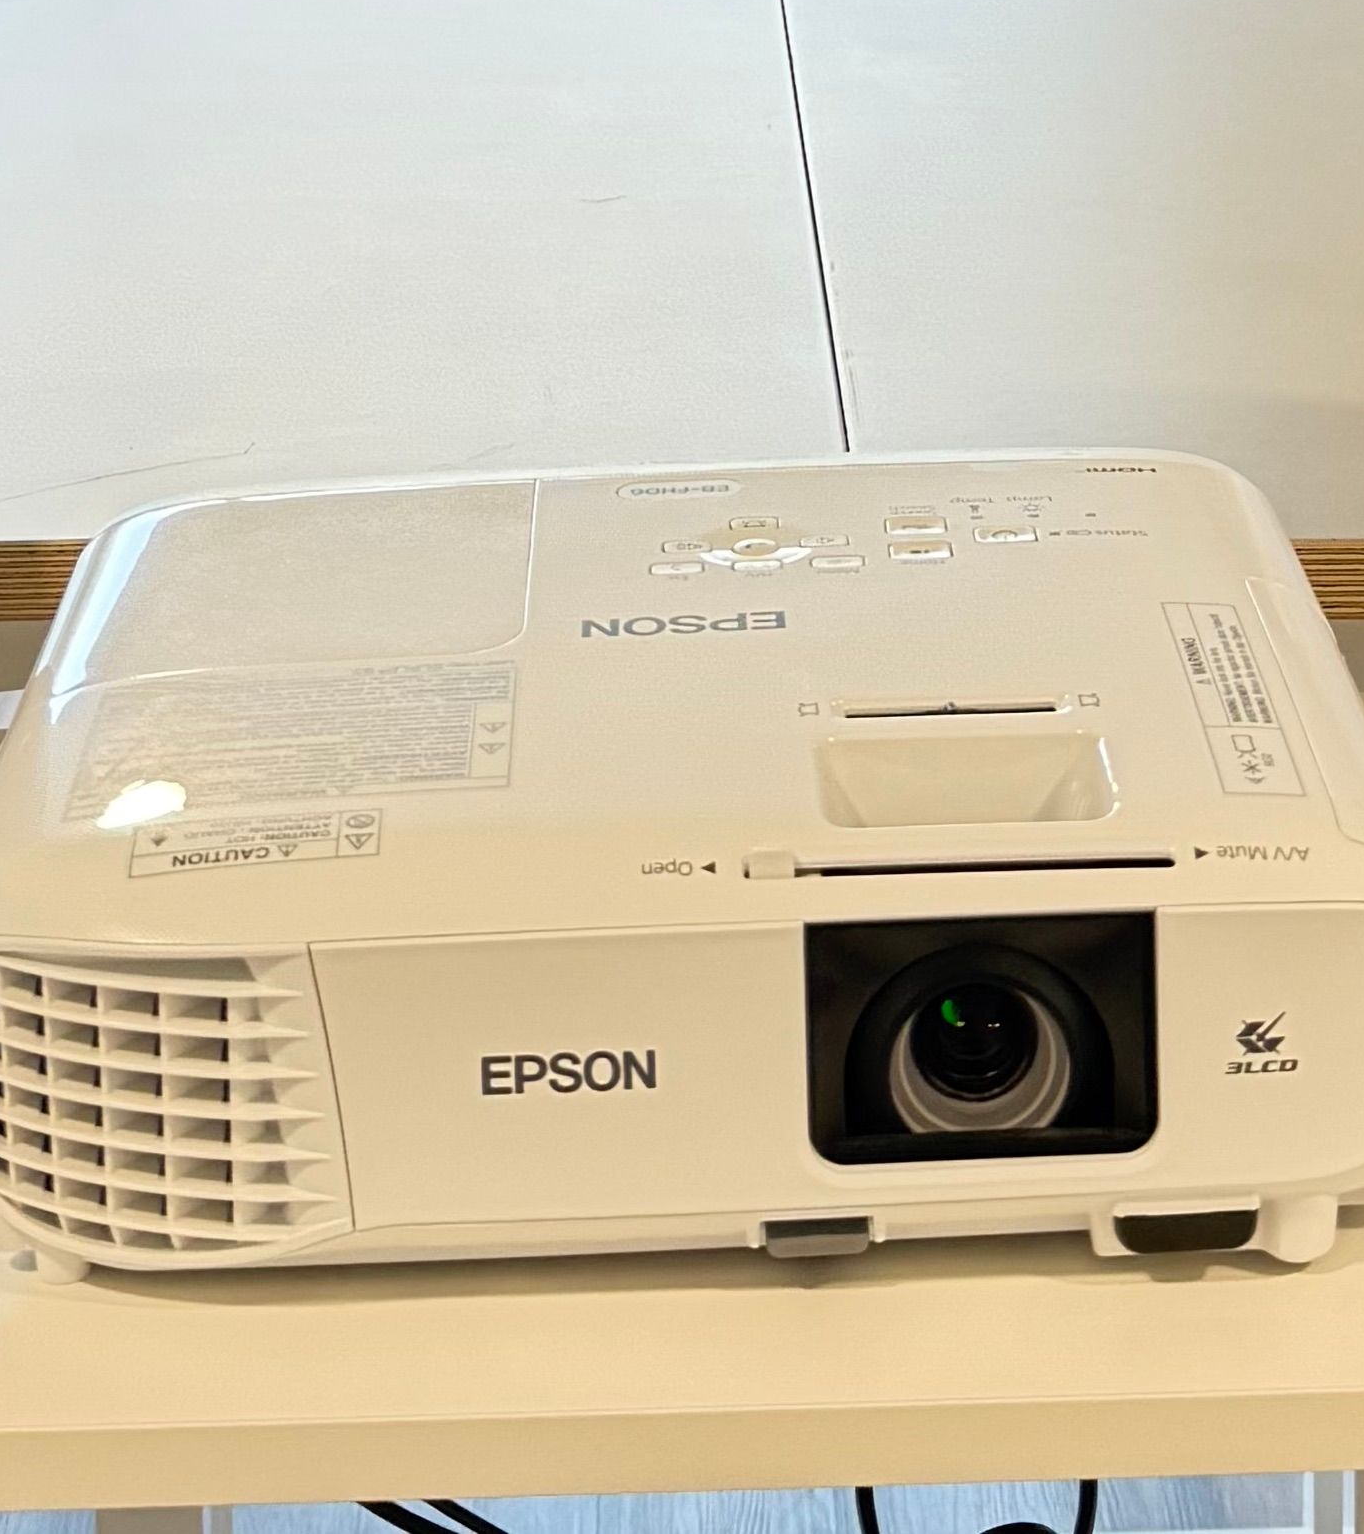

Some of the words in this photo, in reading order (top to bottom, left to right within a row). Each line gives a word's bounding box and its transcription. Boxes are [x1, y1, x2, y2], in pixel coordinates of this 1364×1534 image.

[581, 611, 787, 638] EPSON
[171, 845, 270, 868] CAUTION
[1216, 845, 1268, 861] Mute
[642, 858, 693, 877] Open
[481, 1049, 657, 1095] EPSON
[1225, 1059, 1298, 1074] 3LCD
